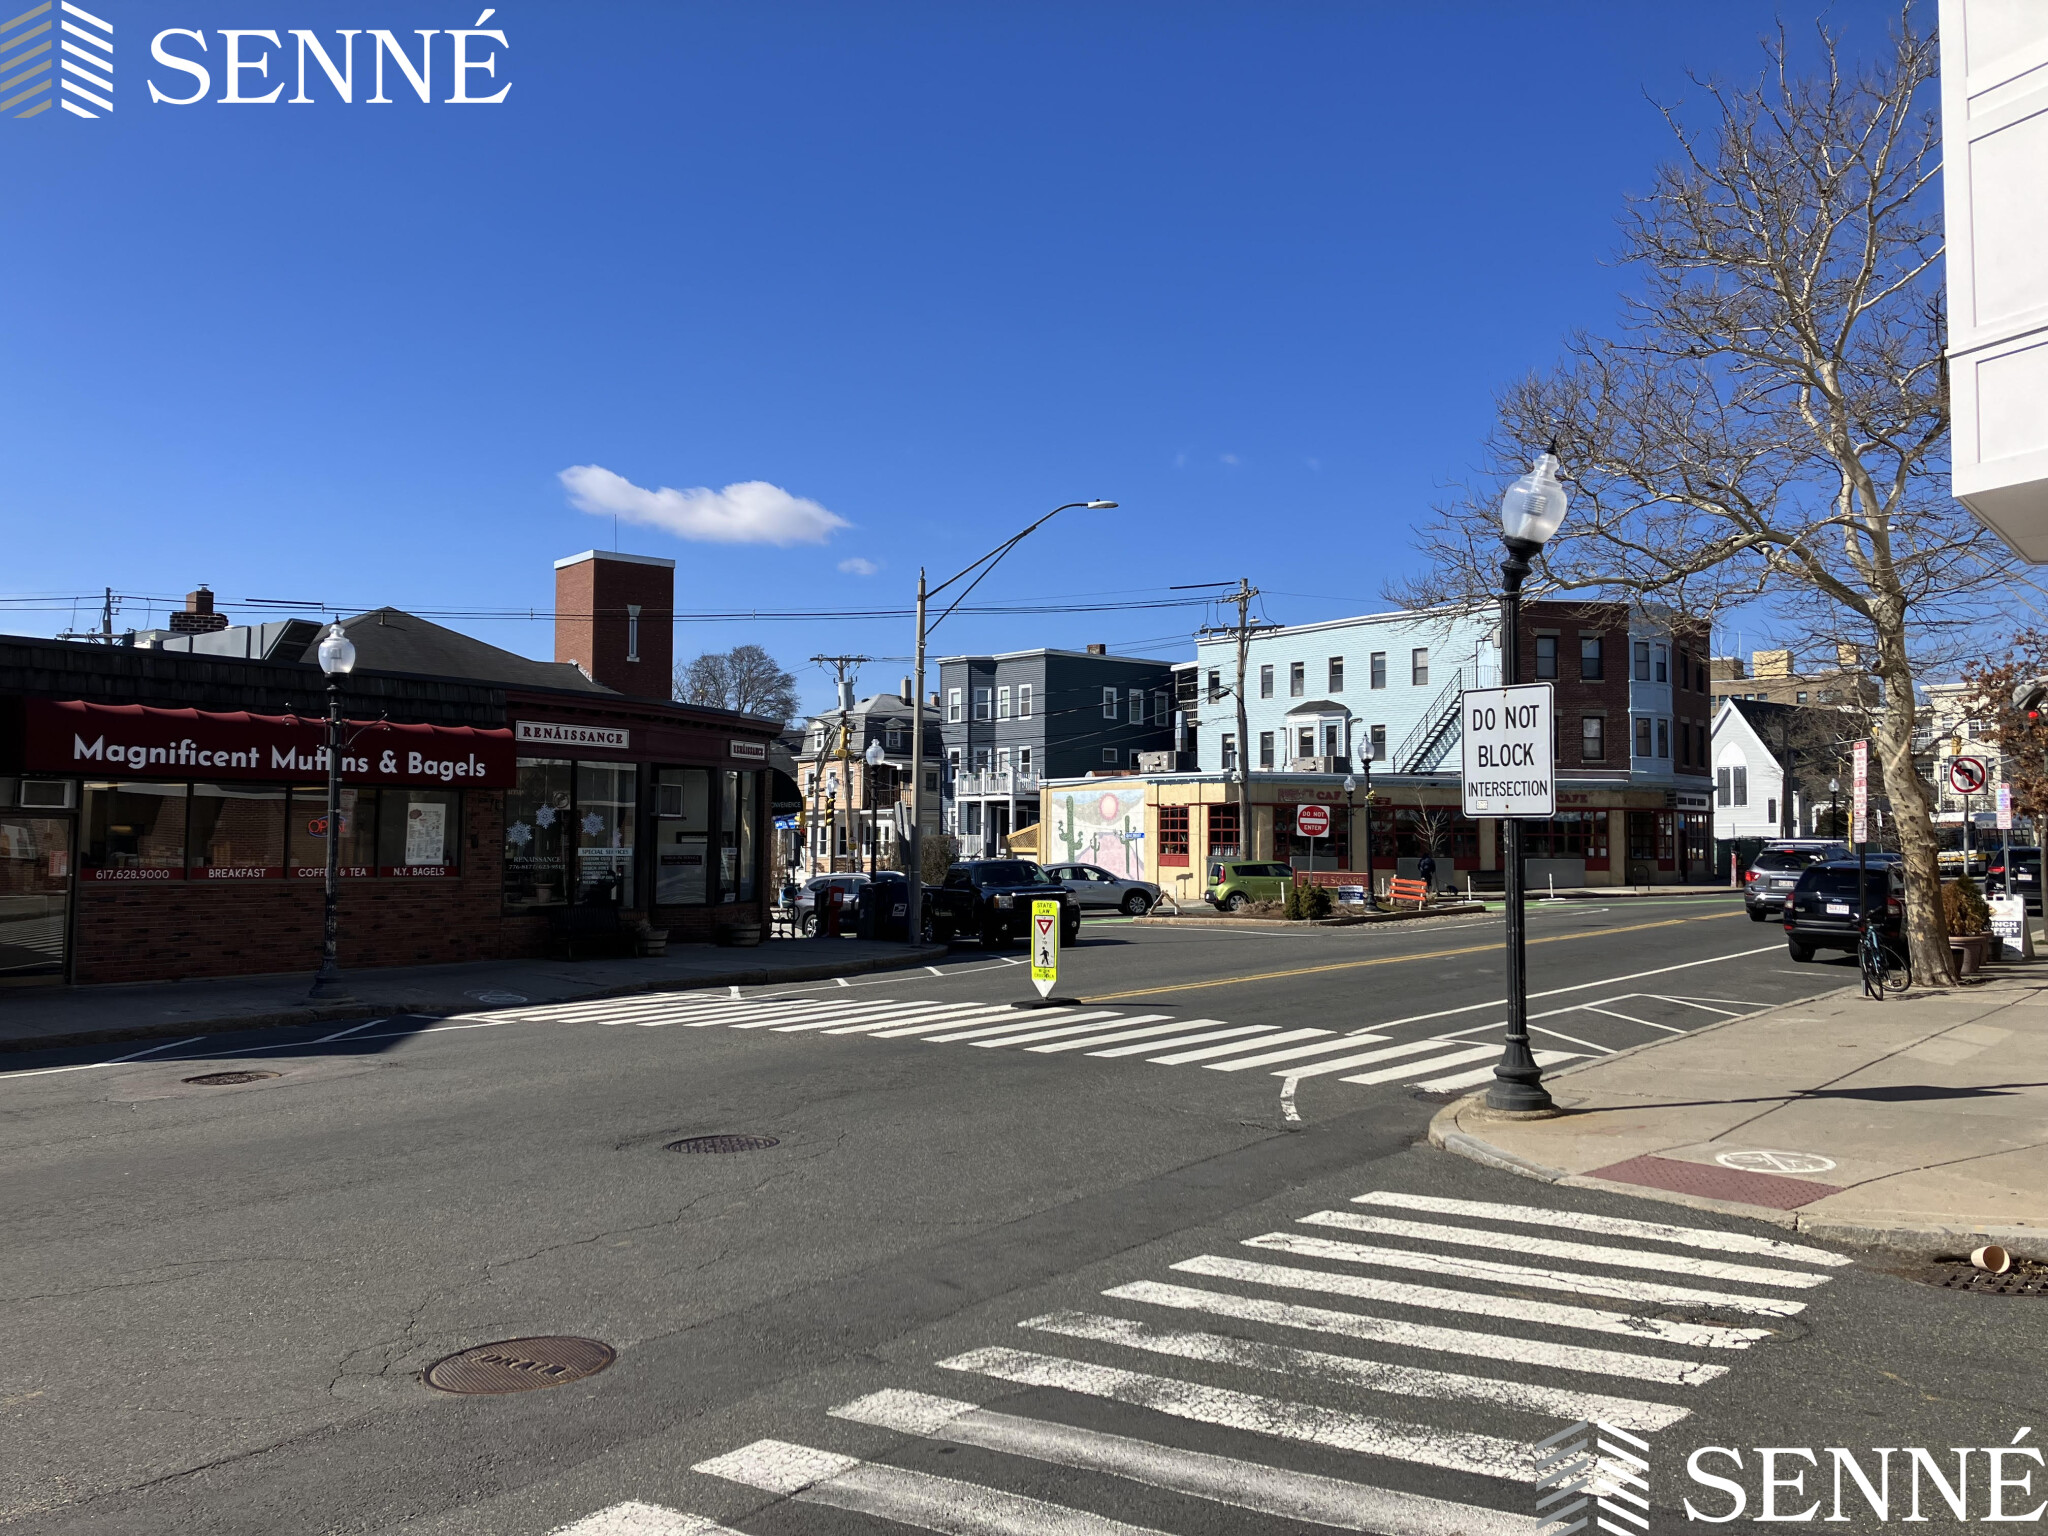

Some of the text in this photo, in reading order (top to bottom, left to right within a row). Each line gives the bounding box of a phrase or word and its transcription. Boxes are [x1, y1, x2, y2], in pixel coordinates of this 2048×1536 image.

[1473, 705, 1540, 731] DO NOT
[523, 726, 623, 744] RENÁISSANCE
[74, 733, 486, 781] Magnificent Muffns & Bagels
[1479, 743, 1535, 768] BLOCK
[1468, 780, 1548, 798] INTERSECTION
[308, 820, 345, 833] OPN
[96, 870, 169, 880] 617.628.9000
[208, 868, 266, 878] BREAKFAST
[298, 868, 367, 878] COFF & TEA
[393, 867, 446, 877] N.Y. BAGELS
[1330, 876, 1364, 885] SQUARE
